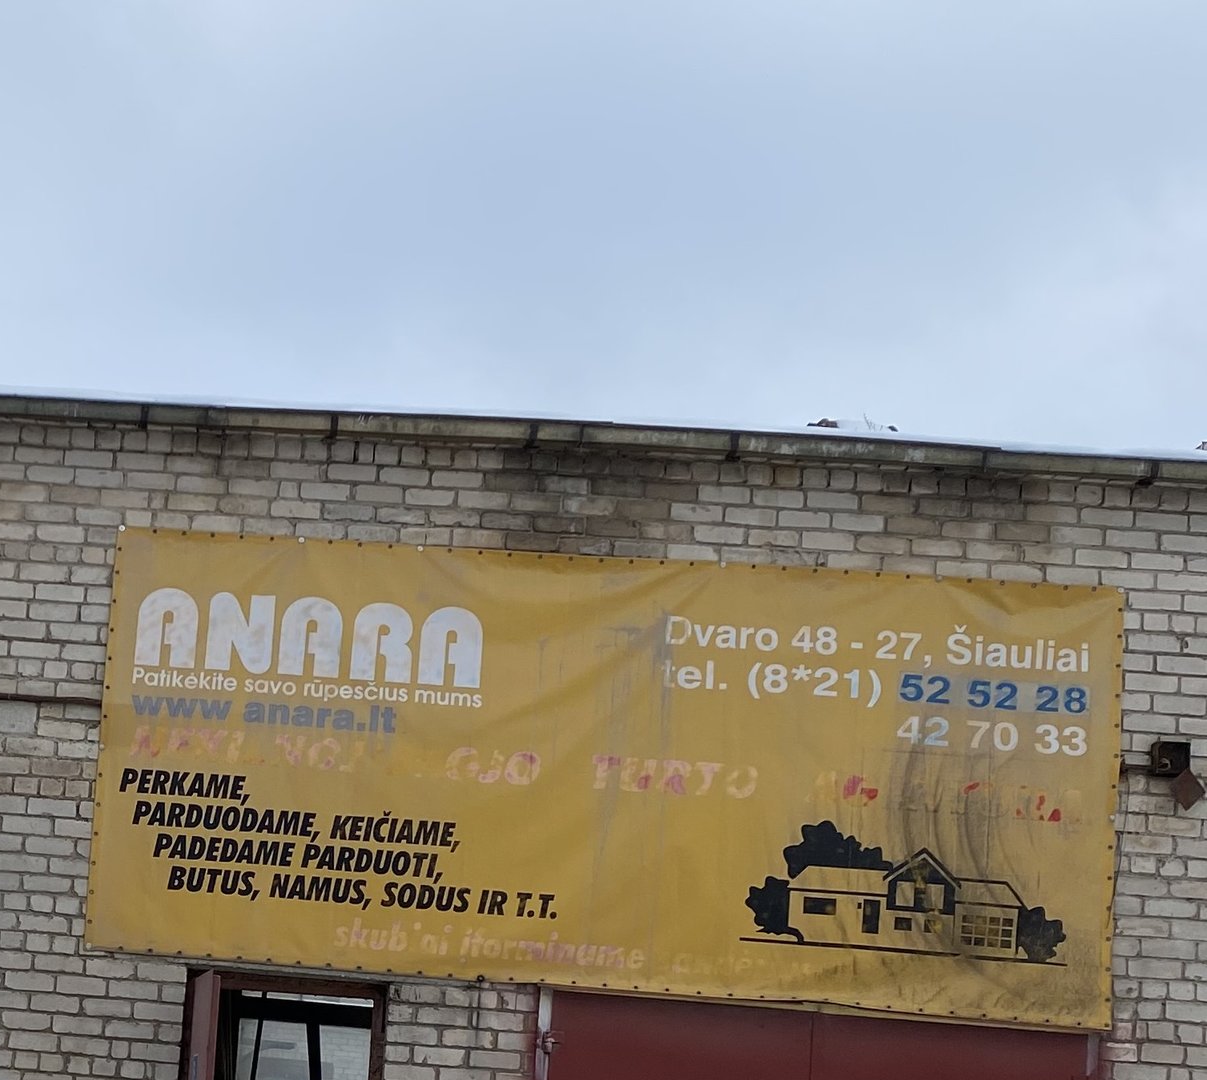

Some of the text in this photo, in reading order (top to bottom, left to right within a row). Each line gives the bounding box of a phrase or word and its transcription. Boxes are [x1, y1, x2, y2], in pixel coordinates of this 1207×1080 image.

[134, 587, 483, 689] ANARA
[665, 615, 779, 651] Dvaro
[792, 625, 838, 655] 48
[875, 630, 932, 668] 27,
[946, 624, 1090, 673] Šiauliai
[132, 667, 483, 708] Patikėkite savo rūpesčius mums
[662, 659, 728, 690] tel.
[899, 674, 951, 705] 52
[967, 680, 1019, 711] 52
[1036, 685, 1087, 714] 28
[896, 716, 1088, 757] 42 70 33
[119, 768, 251, 806] PERKAME,
[132, 800, 461, 853] PARDUODAME, KEIČIAME,
[153, 833, 444, 884] PADEDAME PARDUOTI,
[167, 865, 558, 919] BUTUS, NAMUS, SODUS IR T.T.
